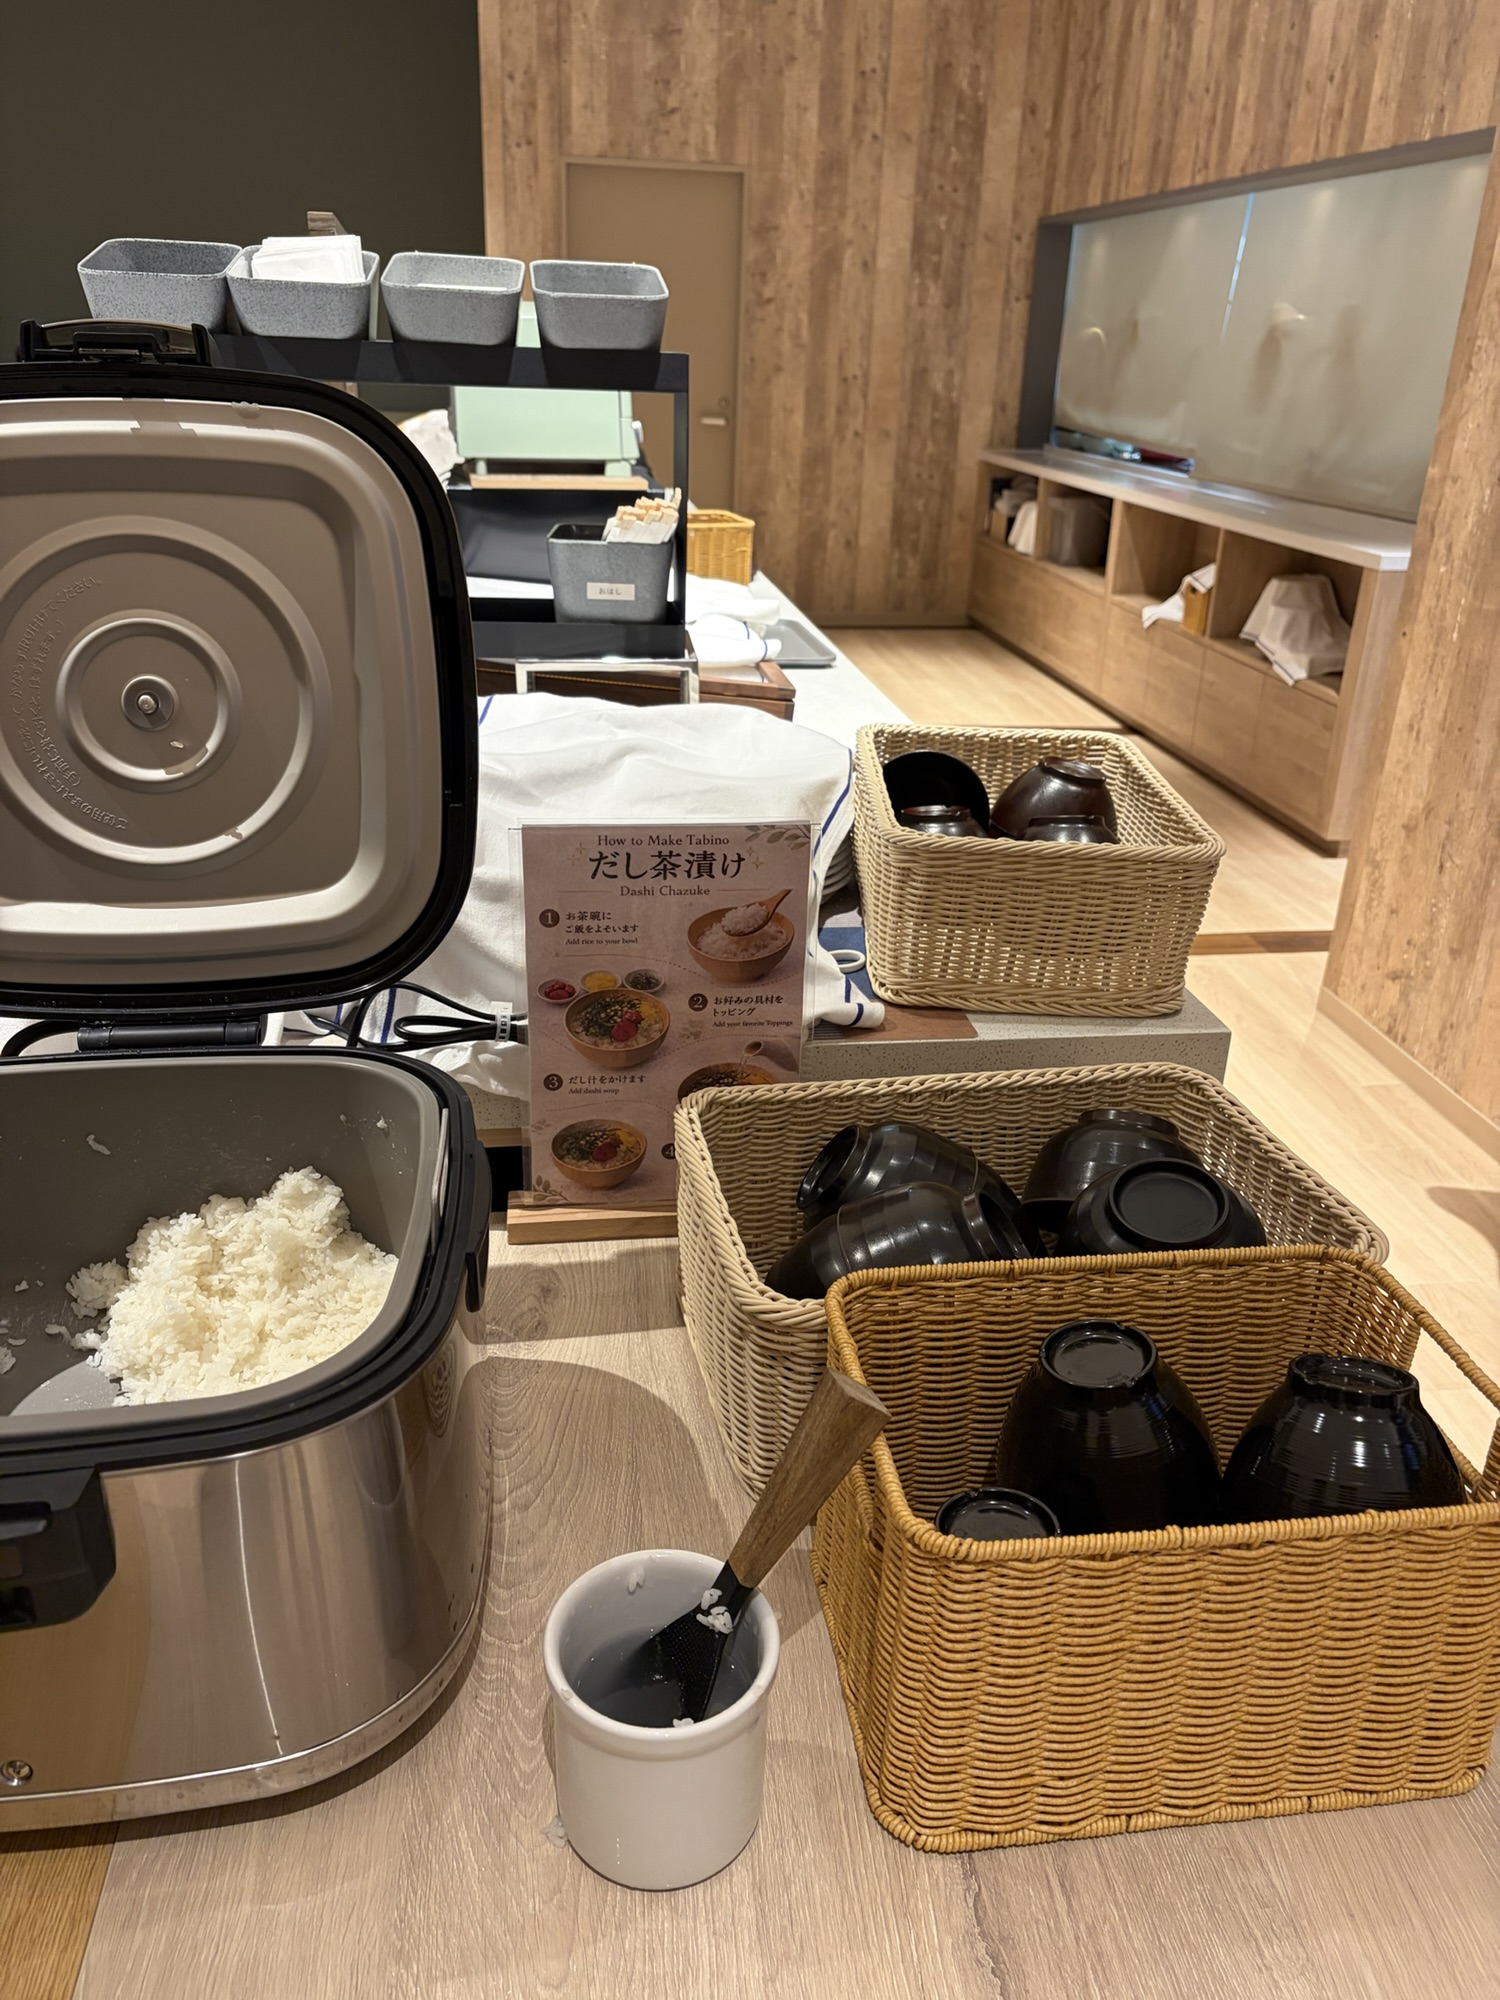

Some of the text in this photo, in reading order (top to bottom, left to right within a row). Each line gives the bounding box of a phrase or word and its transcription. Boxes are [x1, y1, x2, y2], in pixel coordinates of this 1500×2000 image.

[599, 588, 622, 596] おはし
[597, 834, 730, 846] How to Make Tabino
[588, 850, 746, 881] だし茶漬け
[620, 885, 711, 897] Dashi Chazuke
[565, 911, 612, 921] お茶碗に
[565, 924, 639, 934] ご飯をよそいます
[713, 994, 784, 1006] お好みの具材を
[713, 1007, 756, 1017] トッピング
[765, 1020, 793, 1028] Toppings
[568, 1074, 647, 1085] だし汁をかけます
